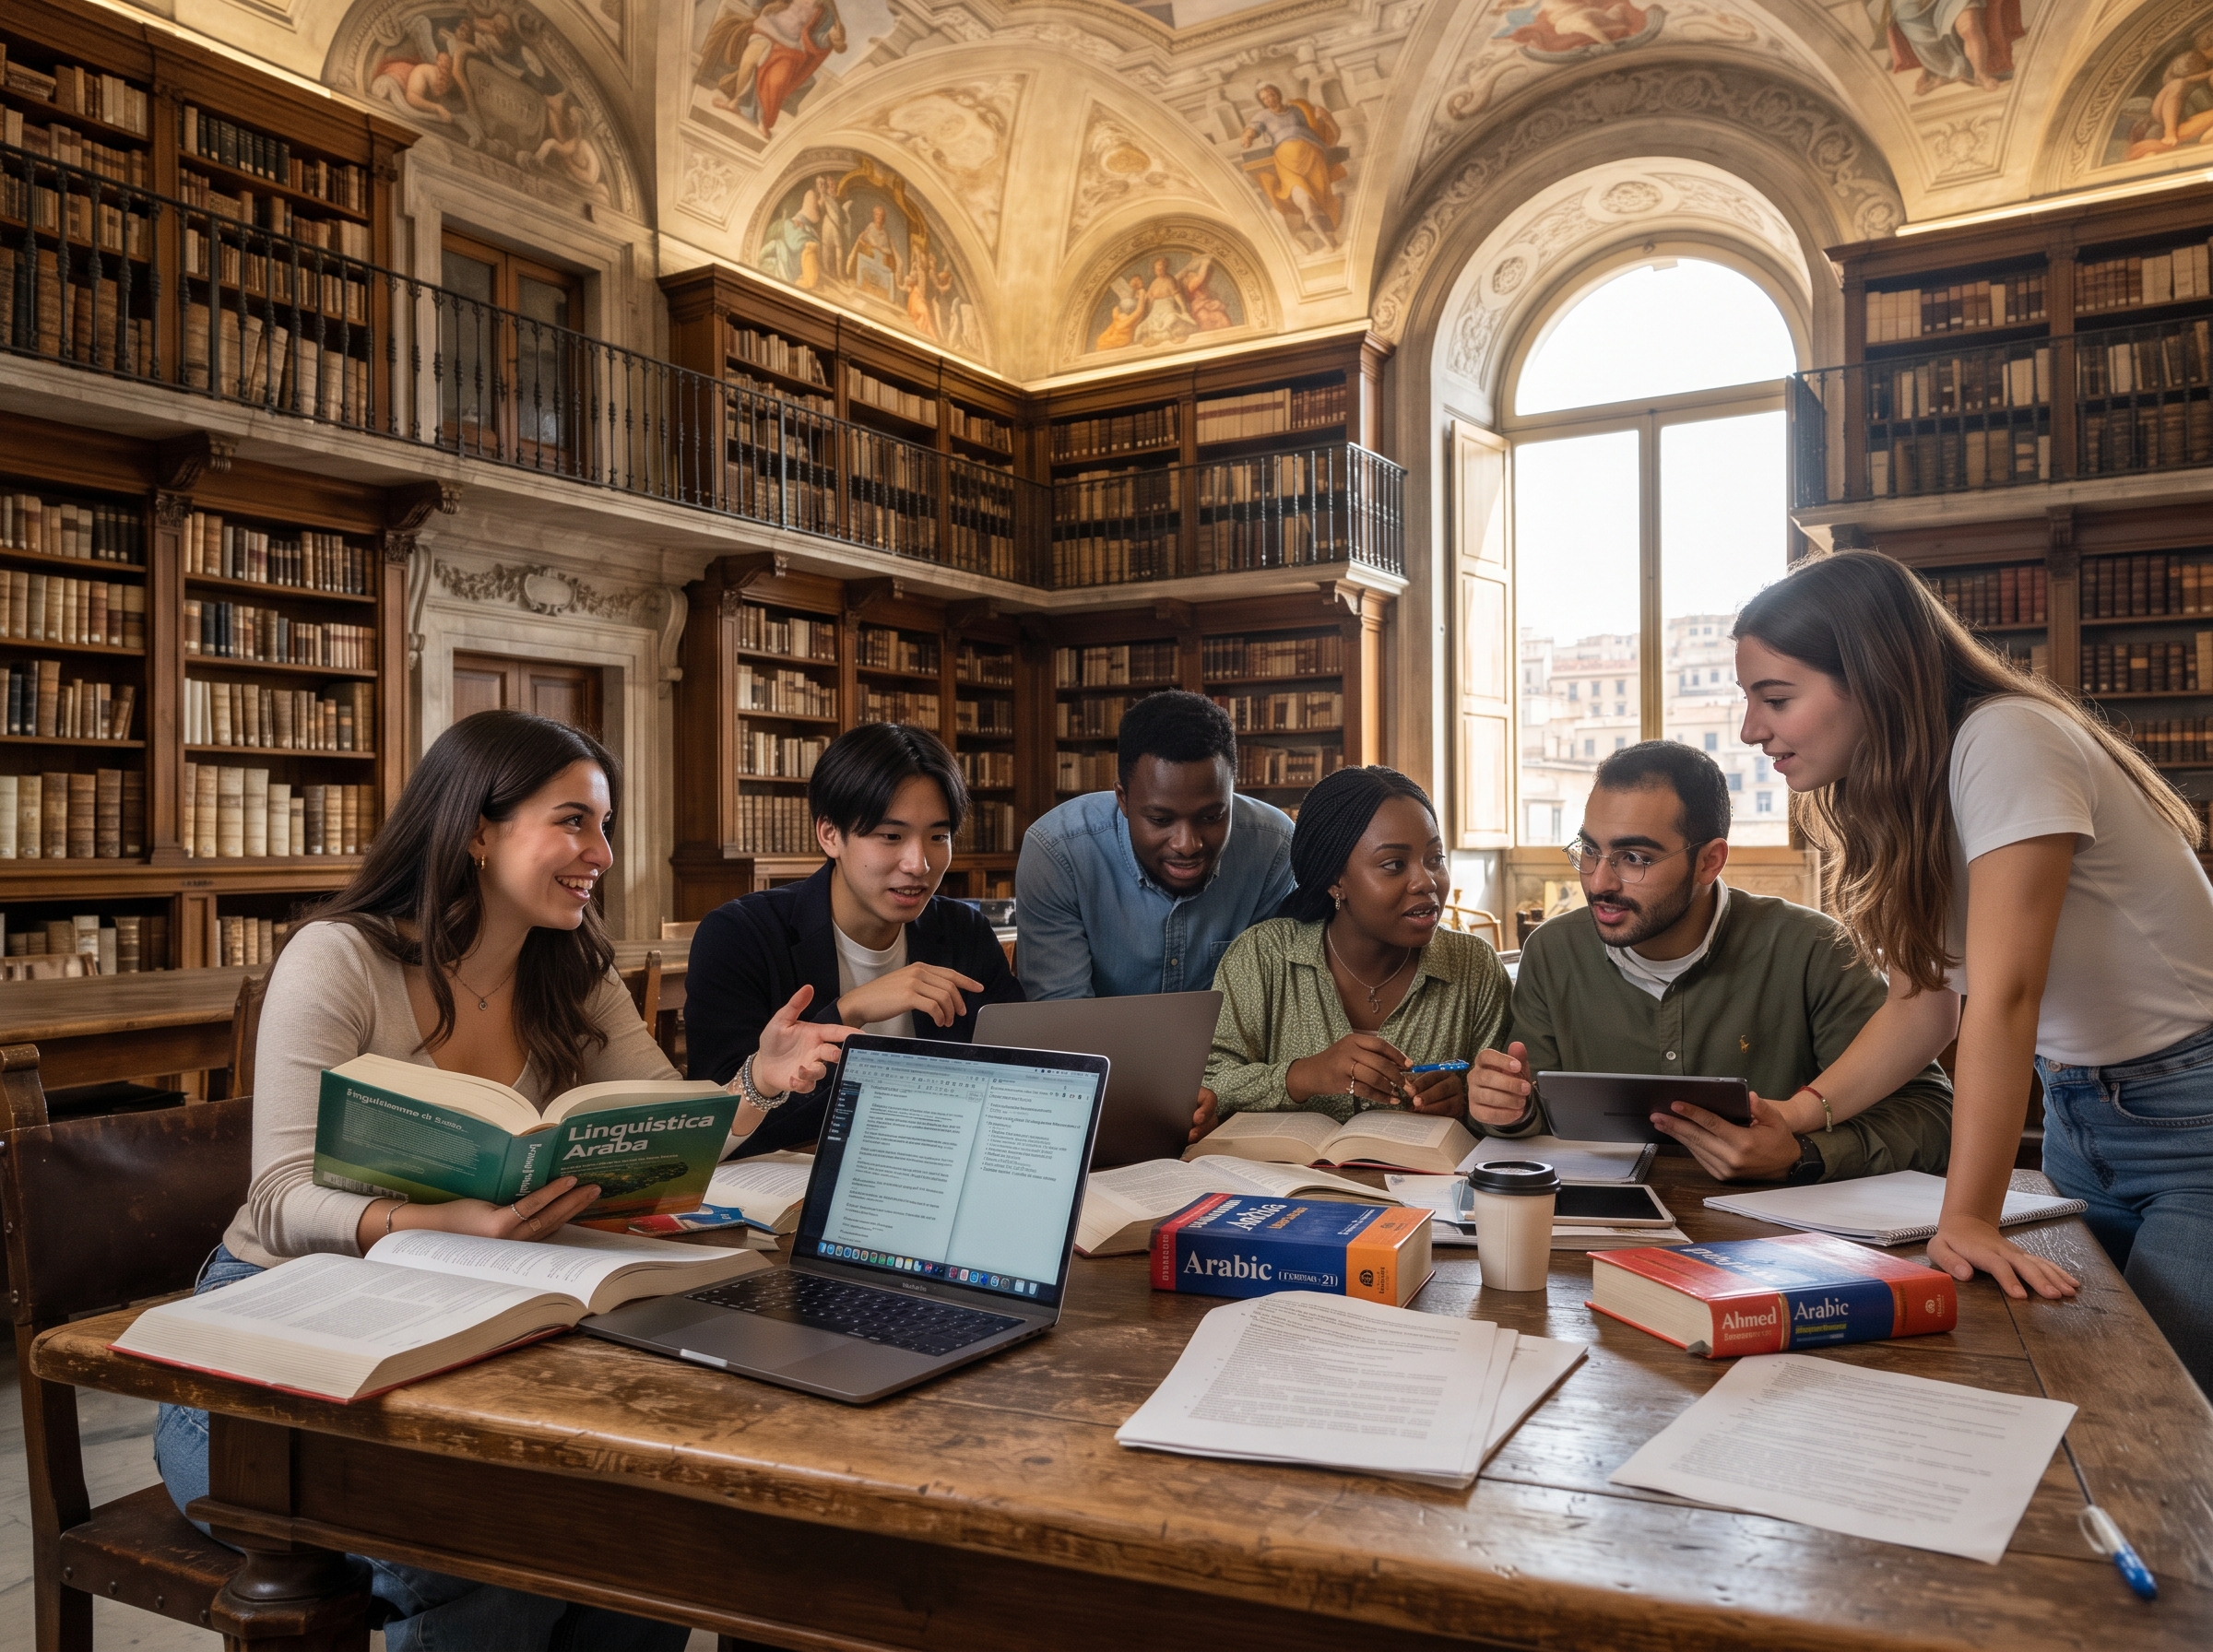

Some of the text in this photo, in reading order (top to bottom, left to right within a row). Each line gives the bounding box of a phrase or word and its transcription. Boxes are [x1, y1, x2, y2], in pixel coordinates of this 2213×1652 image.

[568, 1115, 715, 1142] Linguistica
[562, 1139, 648, 1161] Araba
[1183, 1250, 1272, 1280] Arabic
[1722, 1305, 1777, 1329] Ahmed
[1793, 1297, 1850, 1320] Arabic
